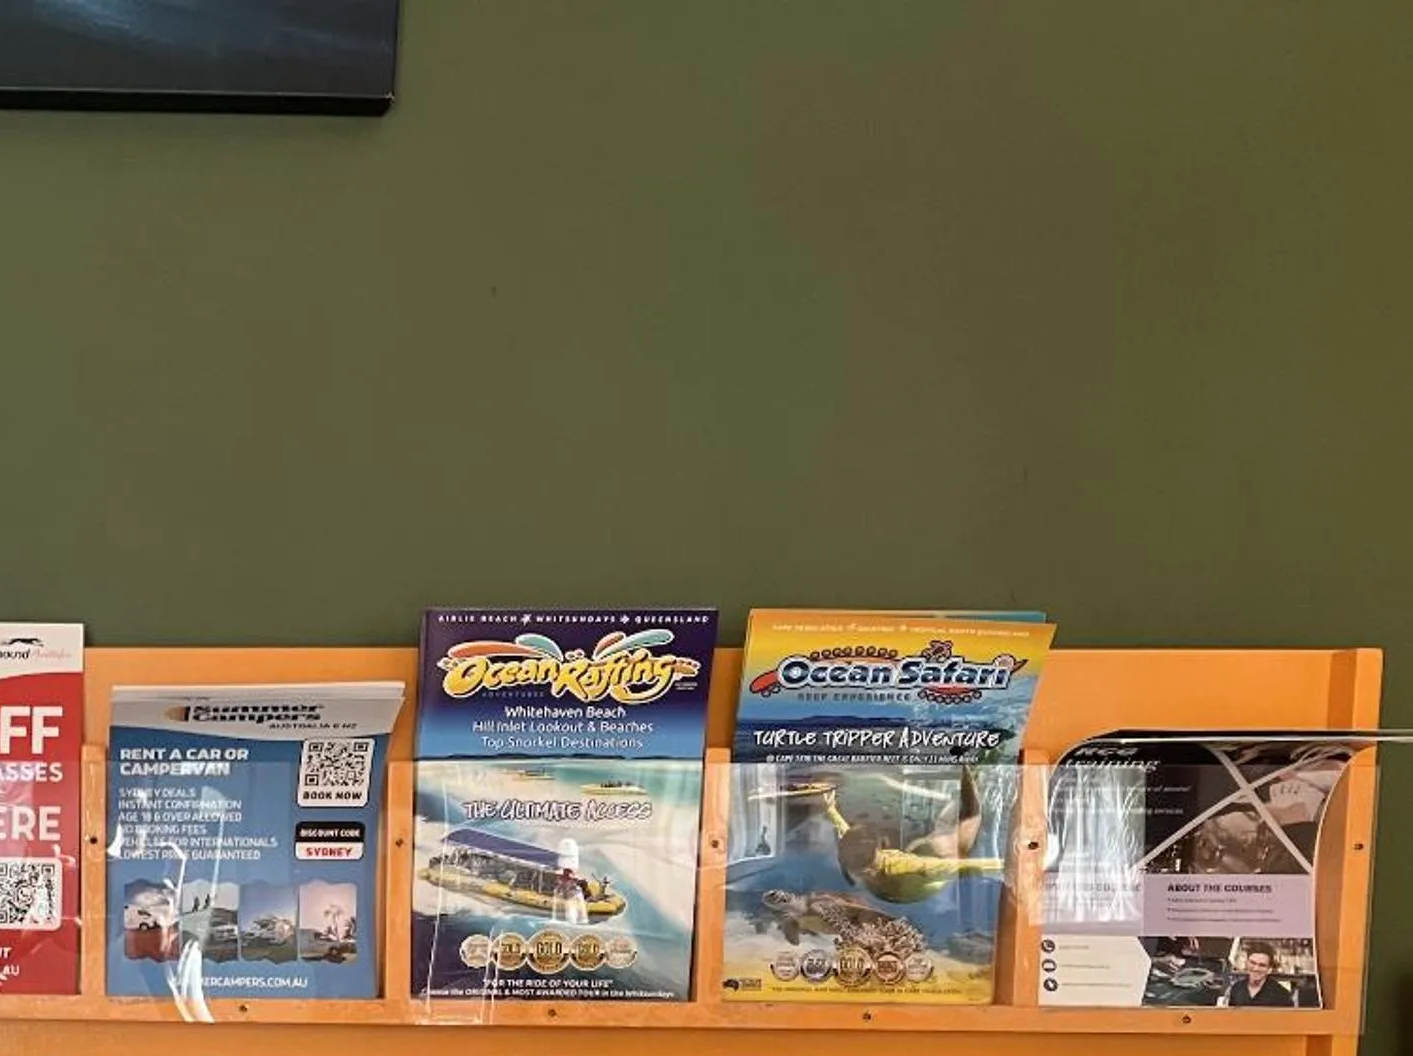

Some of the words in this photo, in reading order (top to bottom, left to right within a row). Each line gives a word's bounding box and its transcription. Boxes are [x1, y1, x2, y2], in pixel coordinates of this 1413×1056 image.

[505, 706, 583, 718] Whitehaven
[587, 706, 626, 718] Beach
[530, 721, 584, 733] Lookout
[600, 722, 653, 733] Beaches
[482, 737, 503, 750] Top
[507, 736, 557, 748] Snorkel
[561, 736, 643, 748] Destinations
[120, 748, 165, 760] RENT
[170, 749, 182, 760] A
[186, 749, 221, 760] CAR
[303, 791, 332, 800] BOOK
[337, 791, 362, 800] NOW
